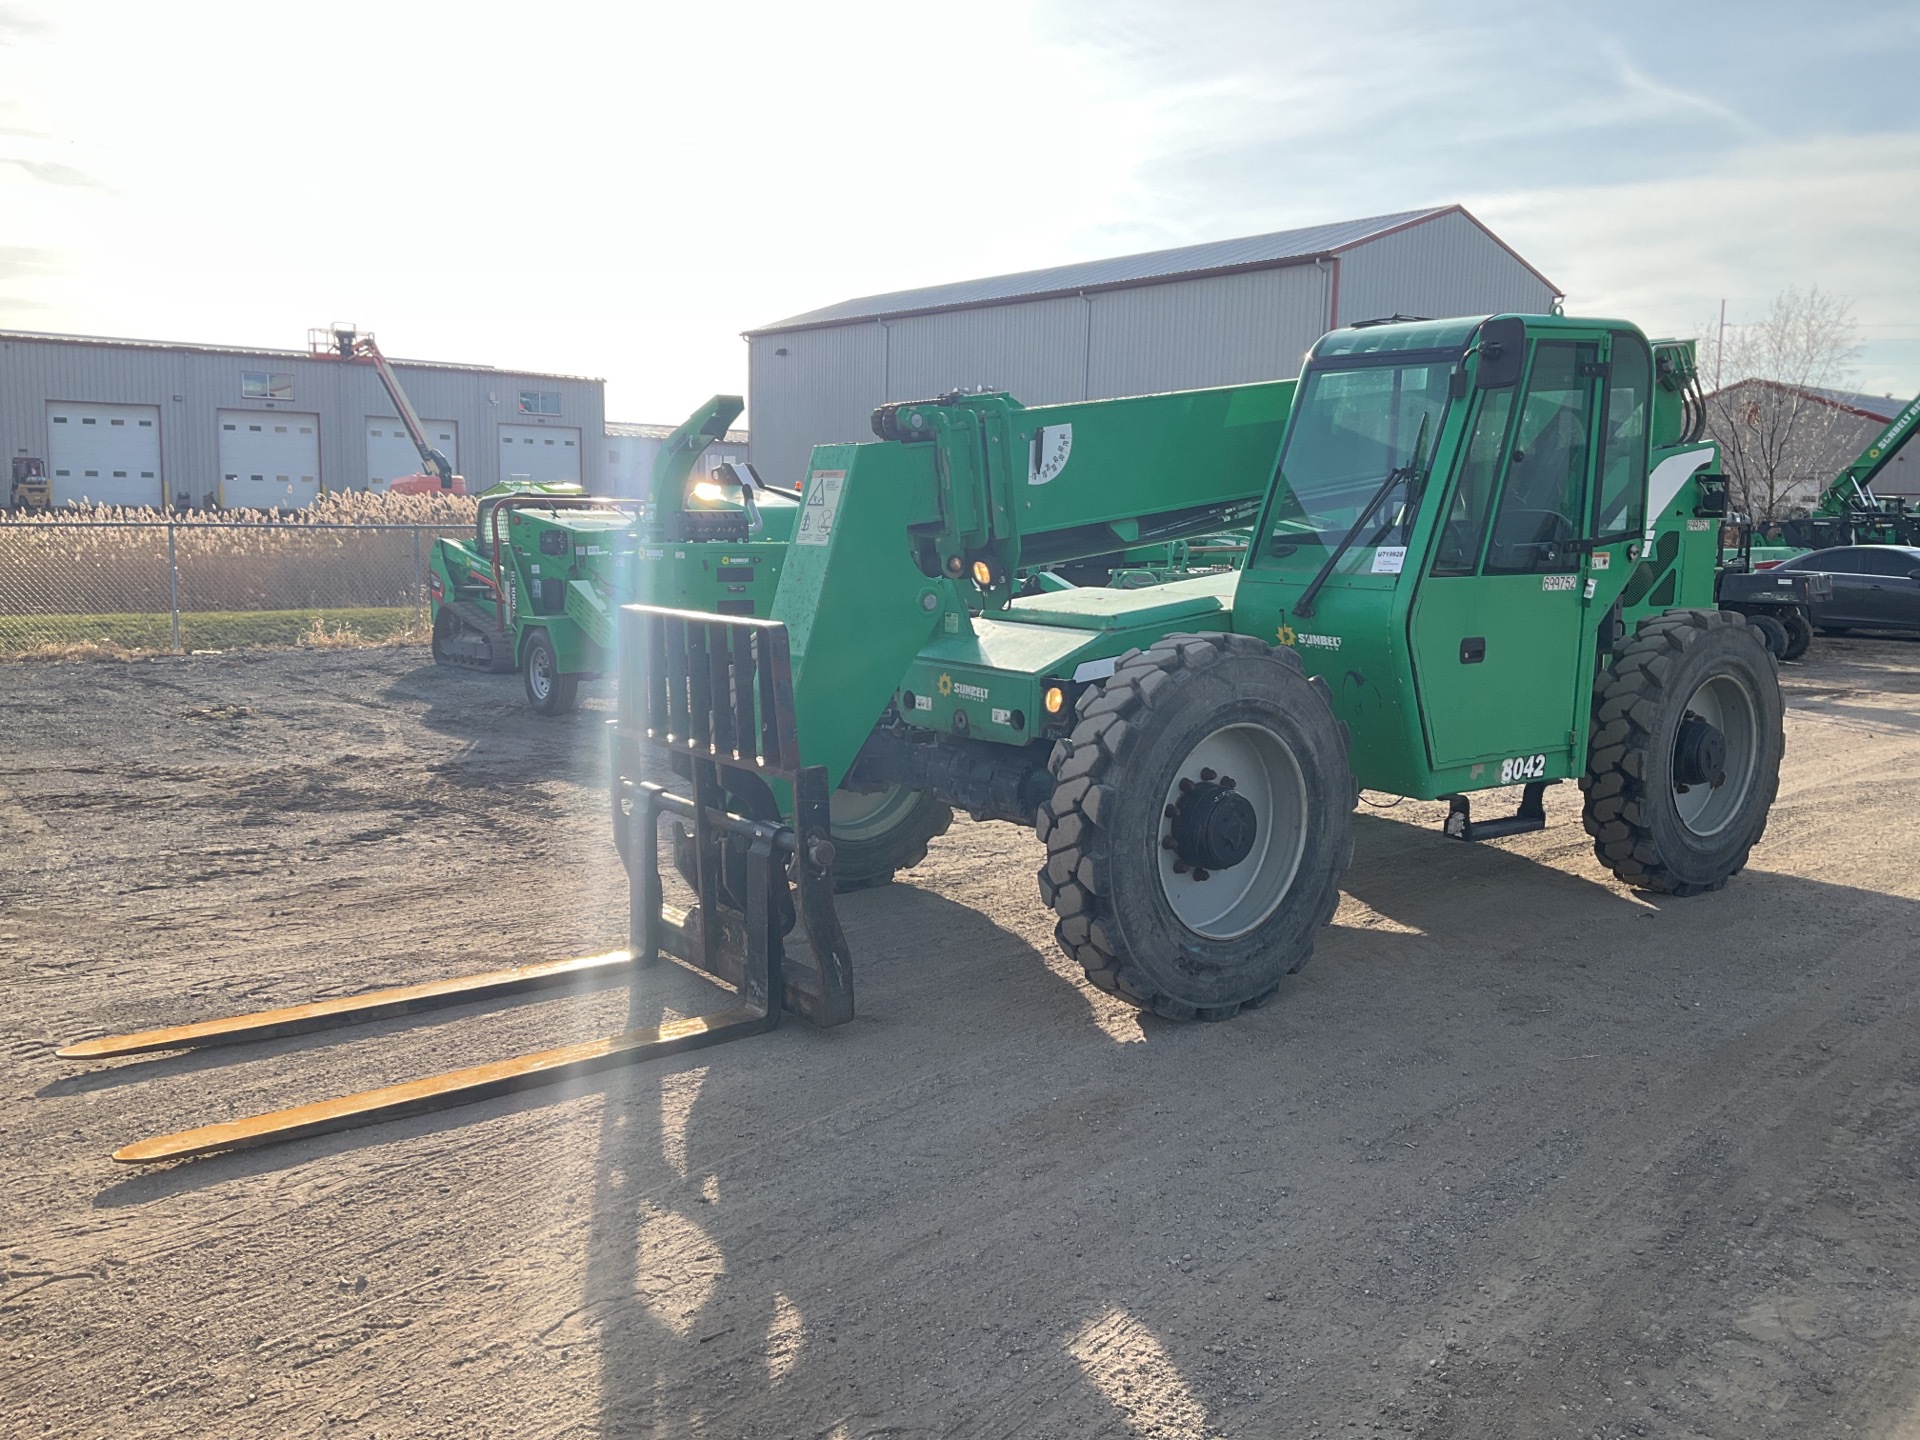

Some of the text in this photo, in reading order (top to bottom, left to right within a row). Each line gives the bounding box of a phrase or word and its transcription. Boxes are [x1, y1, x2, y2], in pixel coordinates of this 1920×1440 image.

[1878, 413, 1912, 450] SUNBELT
[1543, 576, 1576, 590] 699752
[1297, 633, 1342, 647] SUNBELT
[953, 682, 989, 699] SUNBELT
[1501, 753, 1546, 784] 8042
